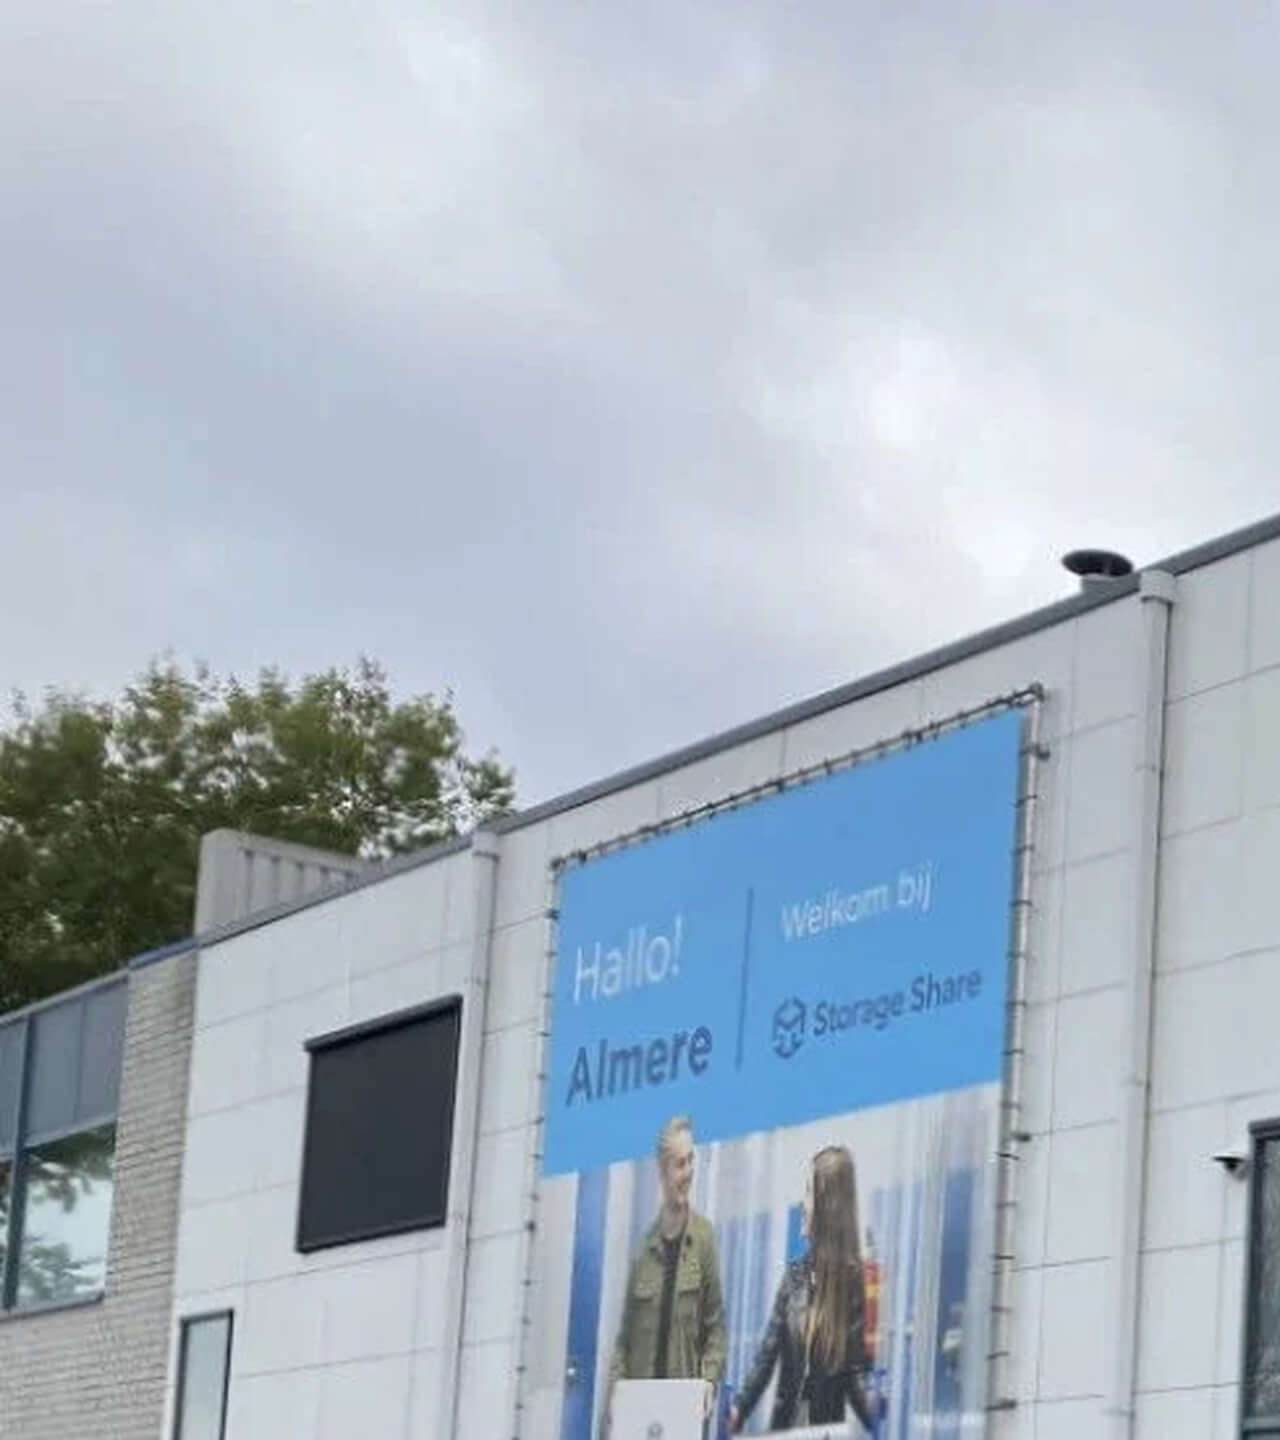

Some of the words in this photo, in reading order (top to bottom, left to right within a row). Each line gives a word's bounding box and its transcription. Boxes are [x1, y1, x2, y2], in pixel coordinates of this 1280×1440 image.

[780, 883, 890, 942] Welkom
[896, 861, 934, 914] bij
[574, 916, 684, 1004] Hallo!
[812, 987, 904, 1038] Storage
[910, 969, 983, 1011] Share
[565, 1024, 713, 1107] Almere
